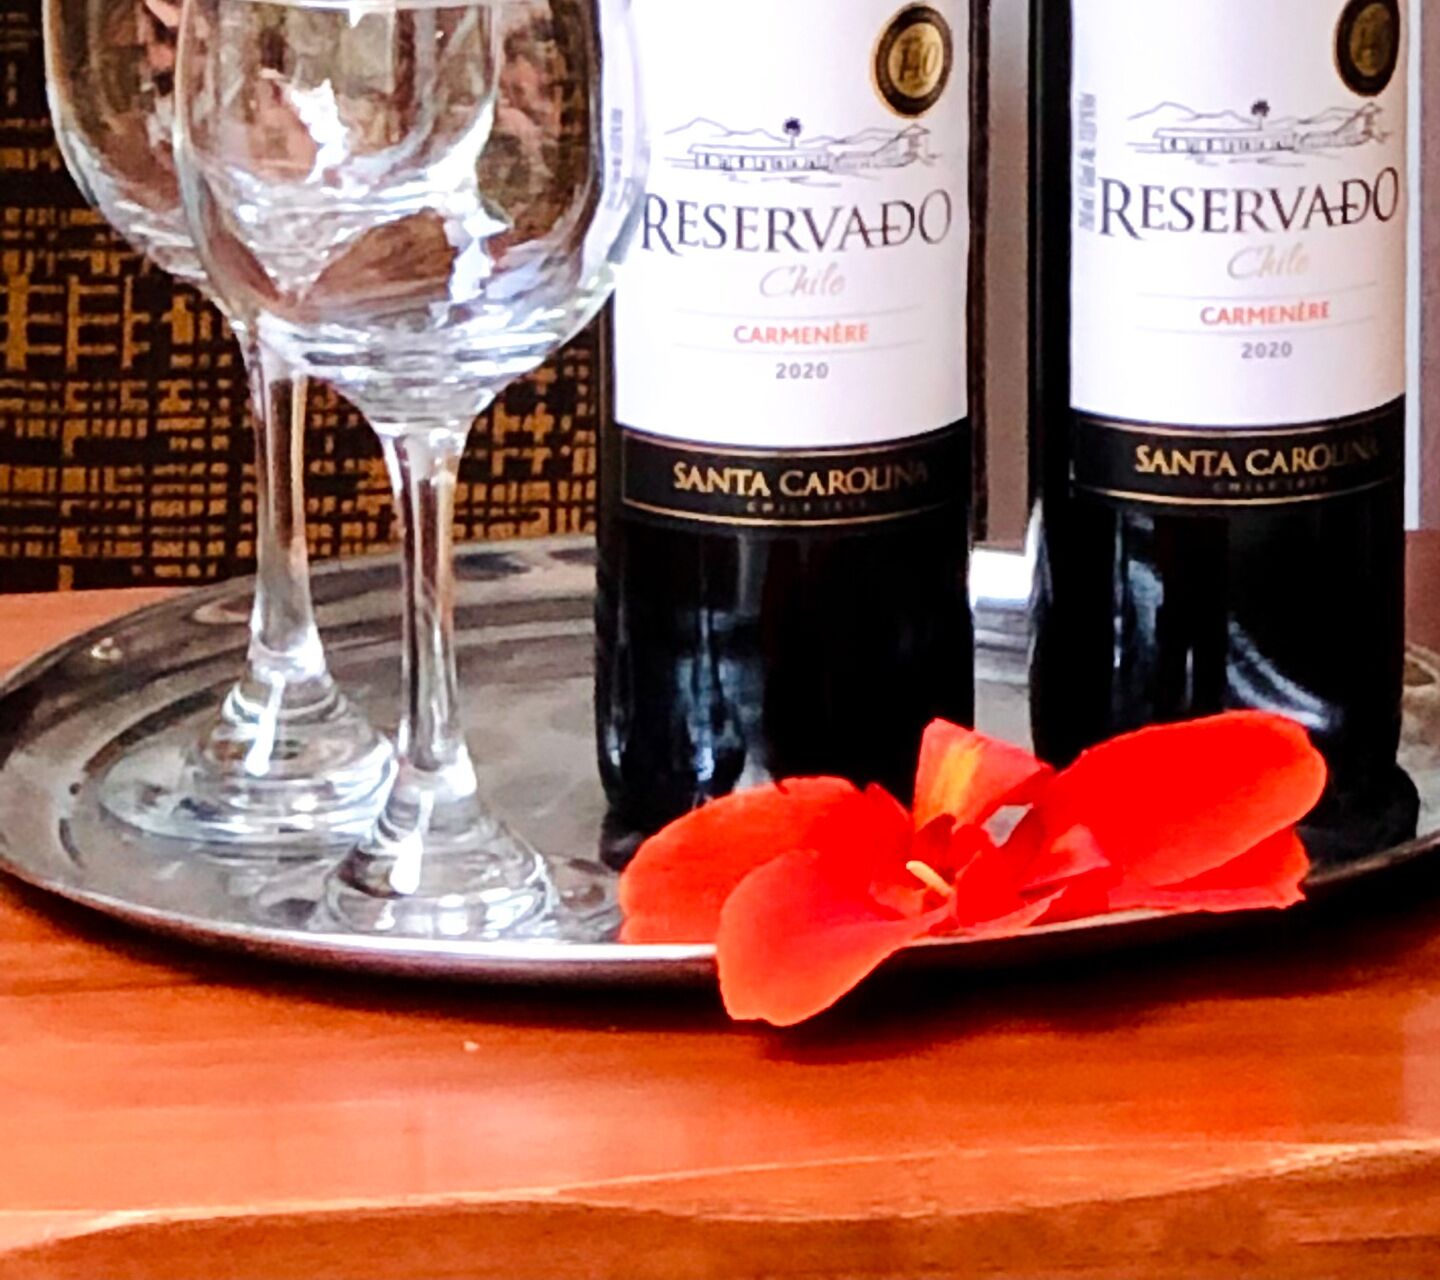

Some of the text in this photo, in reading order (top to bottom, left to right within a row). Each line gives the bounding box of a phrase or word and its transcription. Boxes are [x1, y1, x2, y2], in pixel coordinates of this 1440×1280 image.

[1098, 167, 1399, 240] RESERVADO
[641, 189, 952, 256] RESERVADO
[1226, 241, 1310, 280] Chile
[759, 261, 846, 298] Chile
[1241, 341, 1293, 359] 2020
[775, 362, 829, 380] 2020
[673, 460, 928, 497] SANTA CAROLINA
[1134, 444, 1237, 477] SANTA
